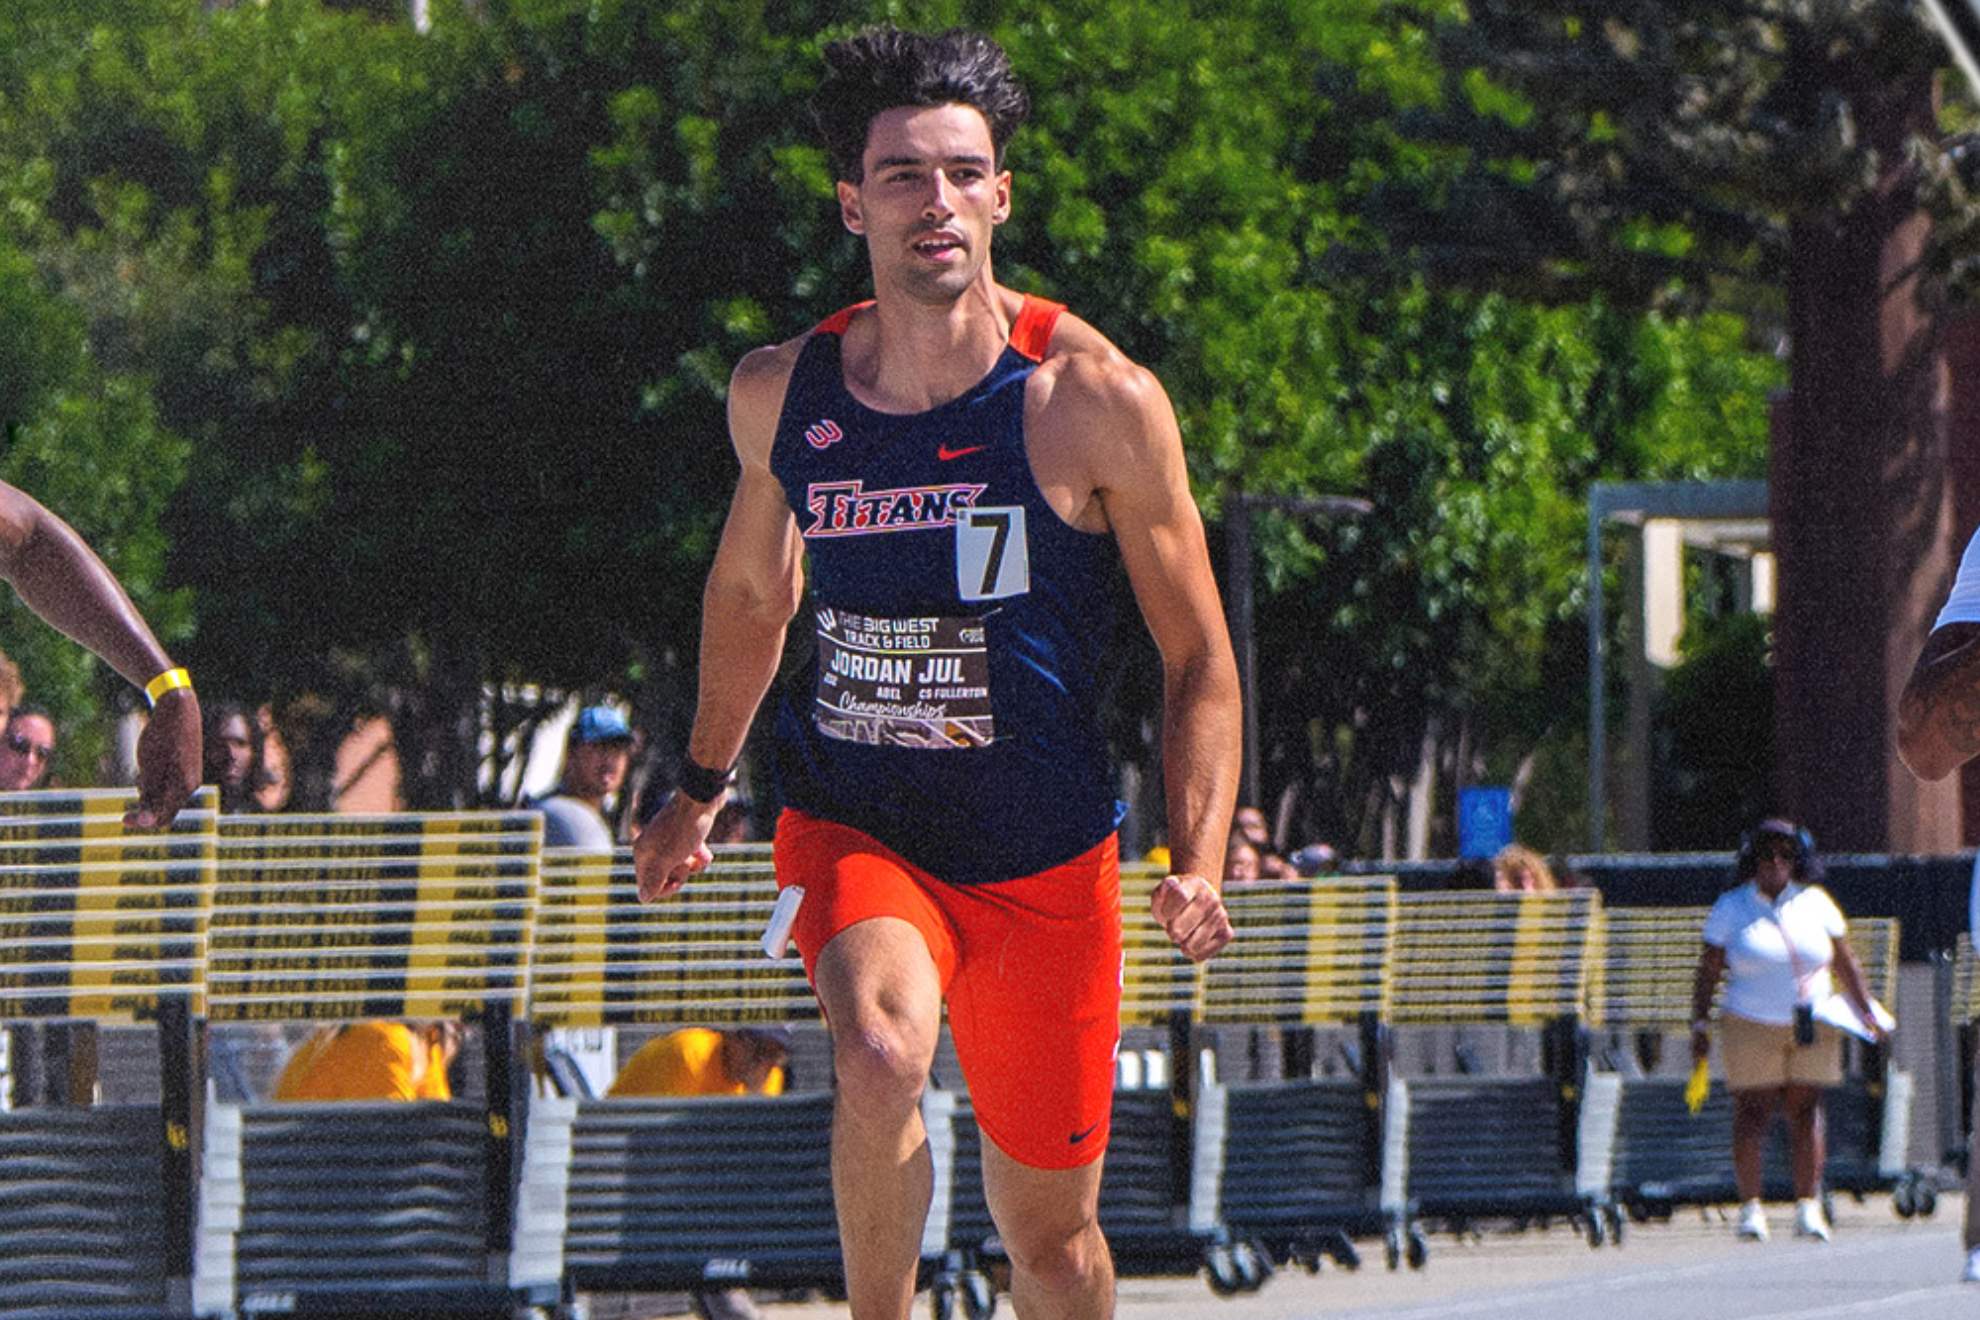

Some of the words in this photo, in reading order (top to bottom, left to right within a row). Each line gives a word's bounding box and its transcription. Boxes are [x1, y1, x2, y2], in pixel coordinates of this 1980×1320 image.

[804, 480, 988, 537] TITANS
[970, 513, 1011, 595] 7
[840, 611, 861, 630] THE
[863, 617, 890, 633] BIG
[893, 617, 939, 633] WEST
[844, 630, 880, 648] TRACK
[882, 635, 892, 648] &
[895, 635, 930, 649] FIELD
[830, 649, 912, 684] JORDAN
[918, 658, 965, 684] JUL
[839, 691, 946, 719] Championships
[934, 687, 988, 699] FULLERTON
